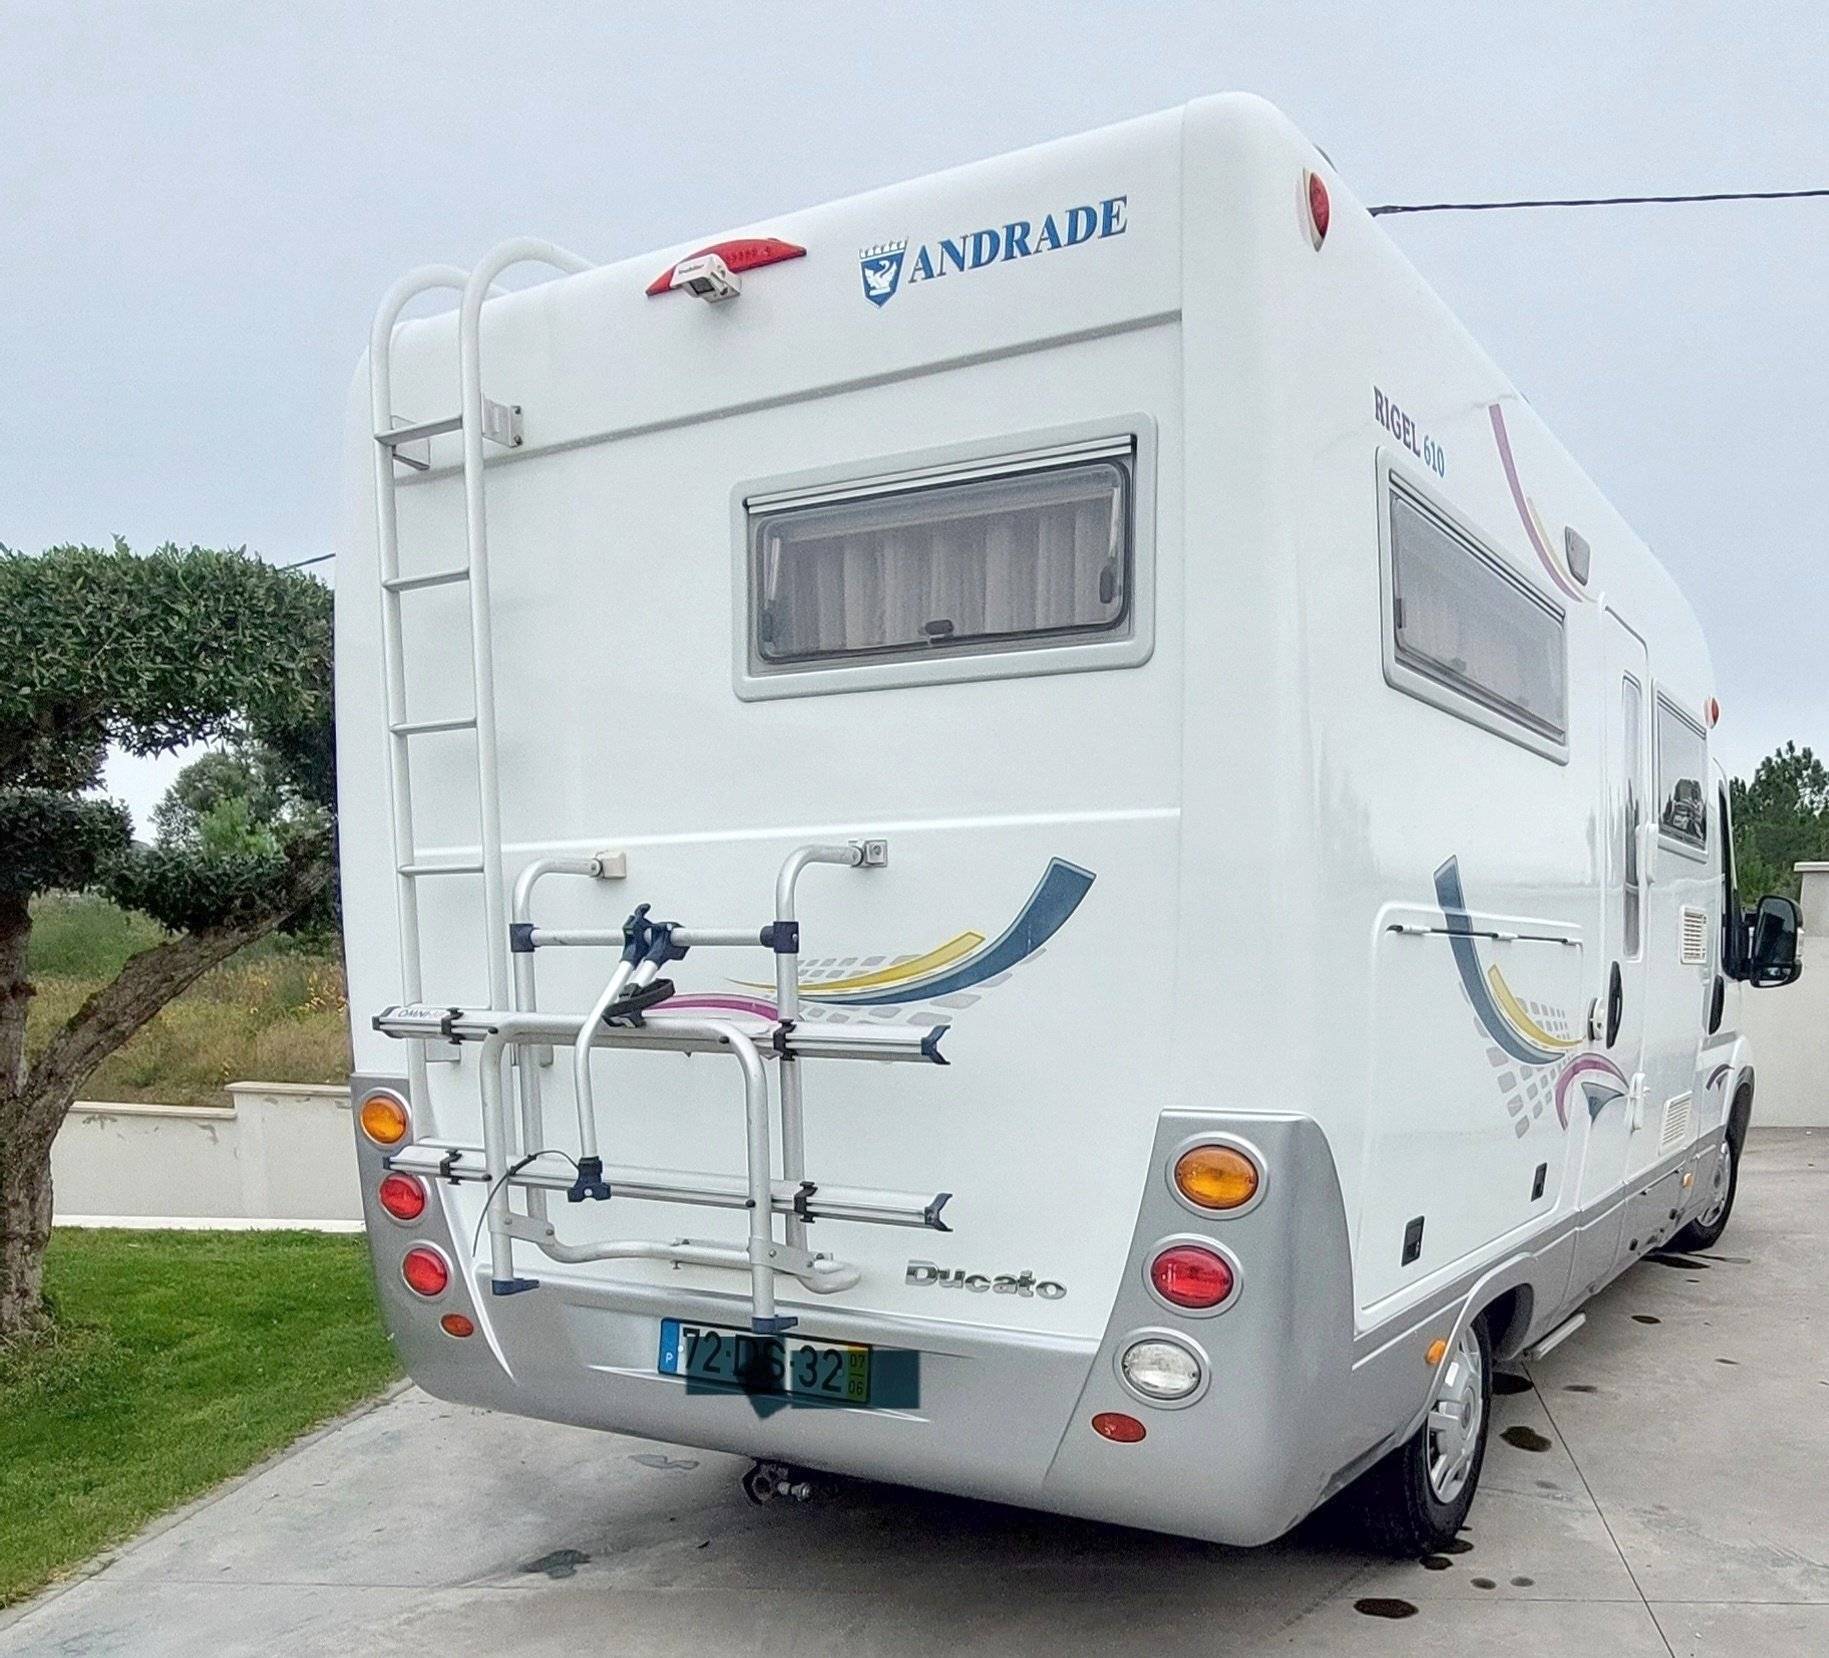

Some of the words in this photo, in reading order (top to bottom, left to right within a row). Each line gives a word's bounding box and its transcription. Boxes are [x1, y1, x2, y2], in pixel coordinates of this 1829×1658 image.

[907, 195, 1128, 284] ANDRADE
[1374, 385, 1421, 459] RIGEL
[1423, 434, 1445, 478] 610
[905, 1259, 1068, 1300] Ducato
[665, 1352, 674, 1364] P
